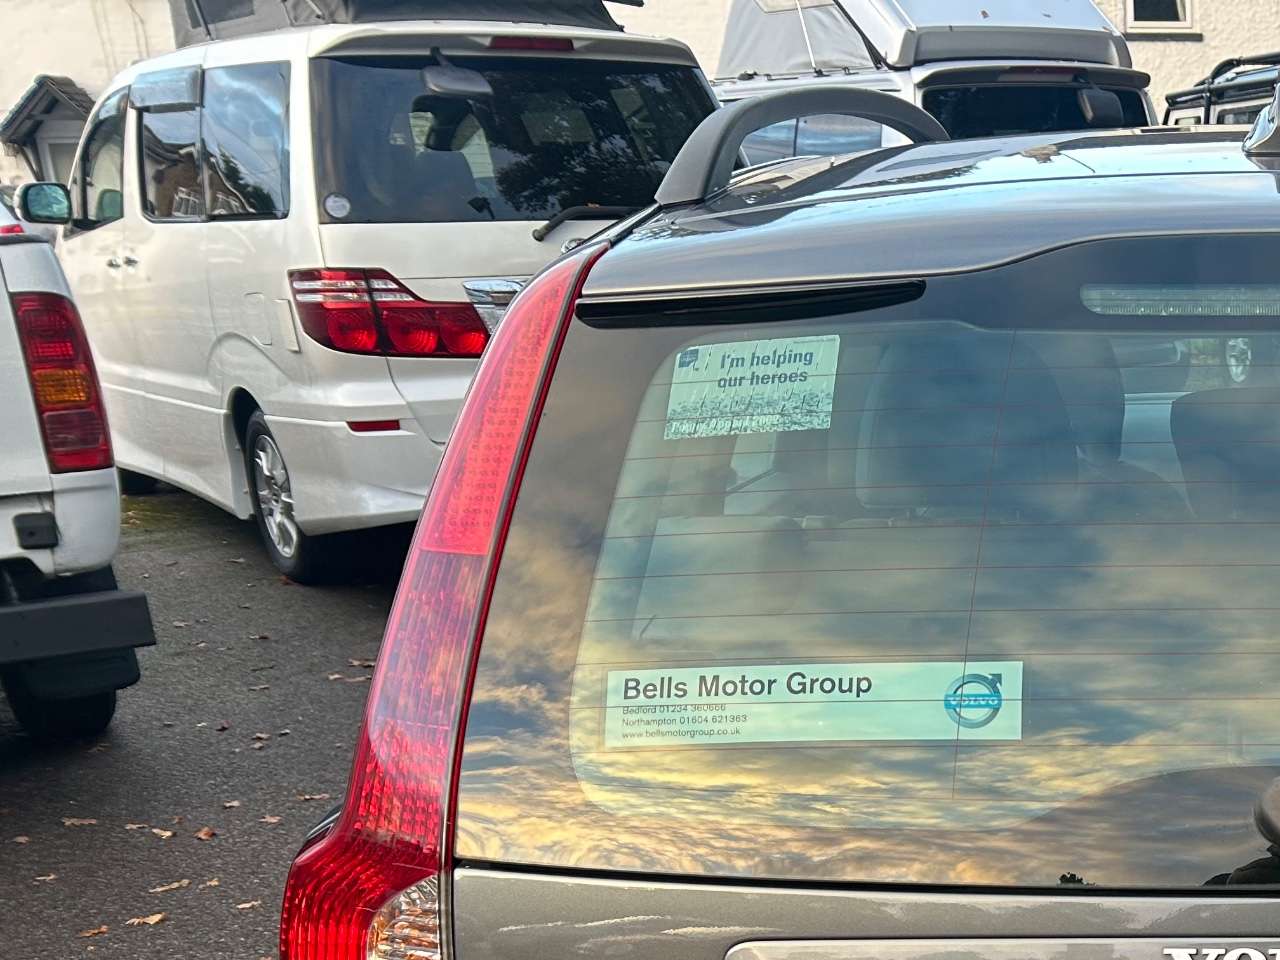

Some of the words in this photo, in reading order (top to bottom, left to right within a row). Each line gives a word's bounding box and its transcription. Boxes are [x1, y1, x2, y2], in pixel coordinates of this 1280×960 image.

[720, 355, 745, 369] I'm
[750, 350, 814, 367] helping
[717, 376, 746, 389] our
[750, 370, 808, 387] heroes
[623, 676, 688, 700] Bells
[698, 674, 777, 697] Motor
[786, 671, 873, 698] Group
[948, 697, 999, 705] VOLVO
[622, 717, 677, 727] Northampton
[679, 716, 708, 725] 01604
